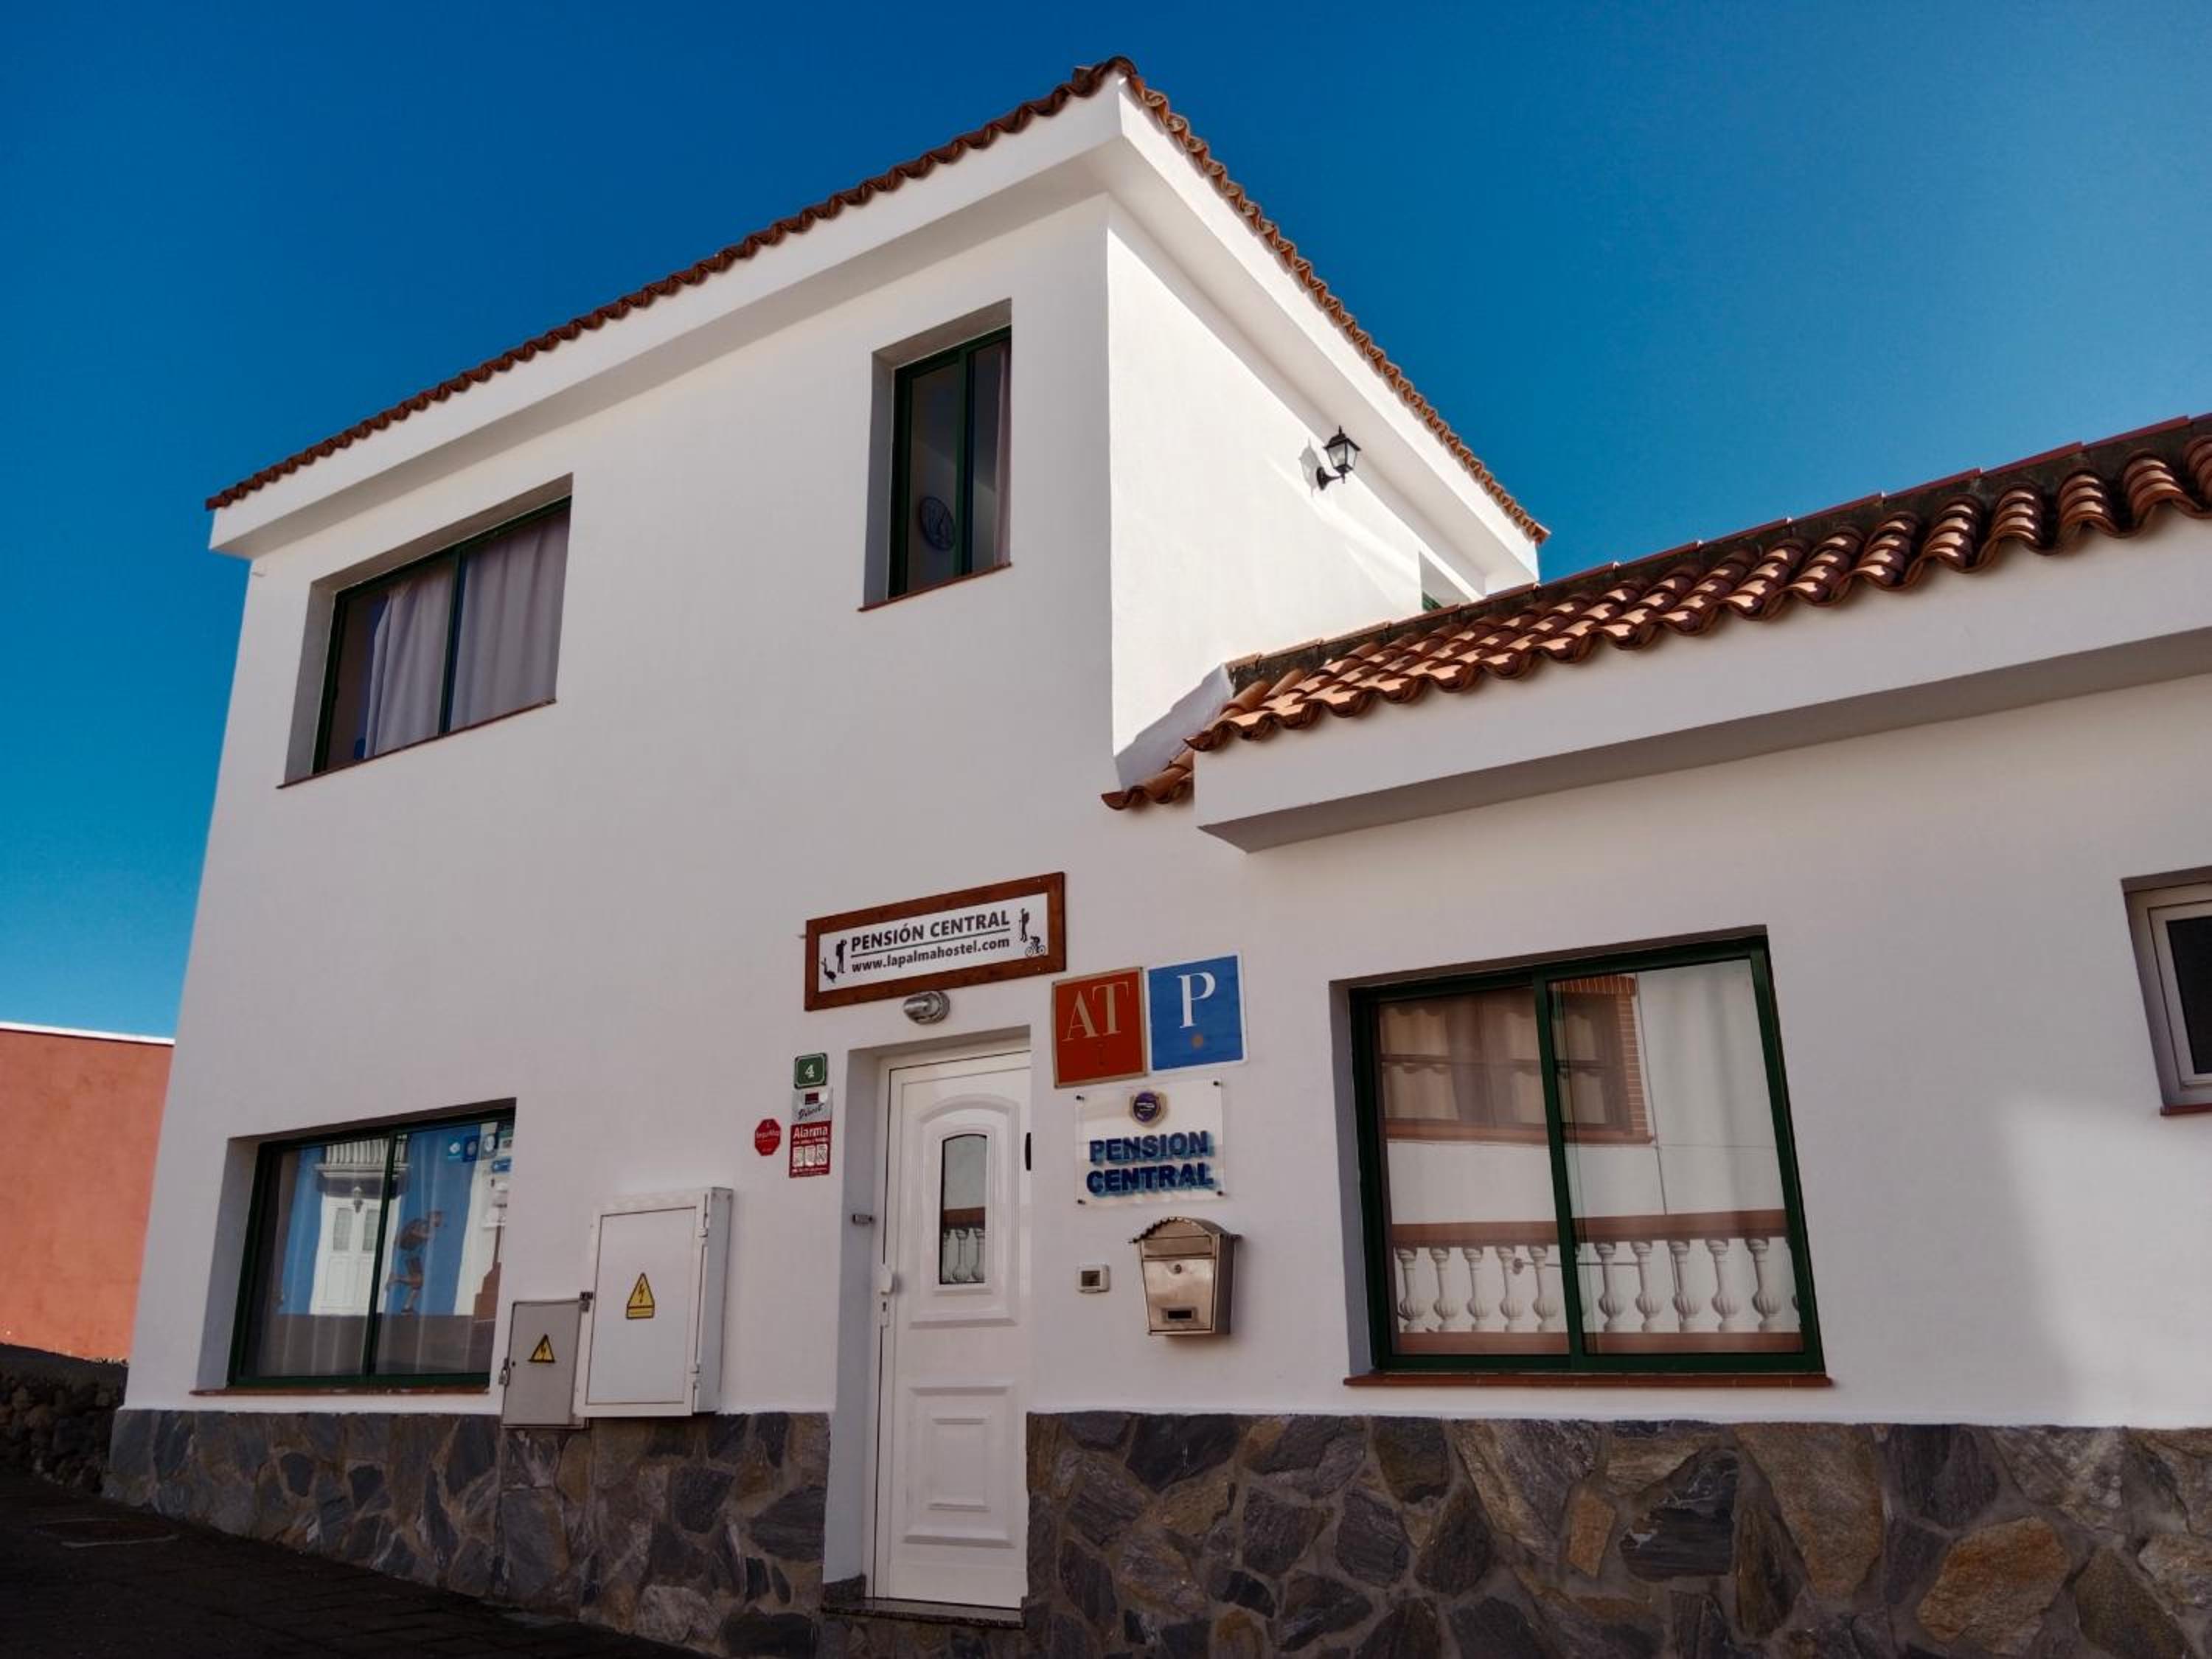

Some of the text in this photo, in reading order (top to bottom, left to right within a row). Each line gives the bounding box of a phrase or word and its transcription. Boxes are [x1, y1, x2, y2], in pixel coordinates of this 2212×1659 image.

[851, 910, 1010, 952] PENSIÓN CENTRAL
[852, 937, 1010, 973] www.lapalmahostel.com
[1061, 981, 1130, 1042] AT
[1177, 971, 1216, 1029] P
[805, 1064, 815, 1079] 4
[793, 1126, 828, 1139] Alarma
[1088, 1130, 1211, 1164] PENSION
[1086, 1162, 1215, 1194] CENTRAL
